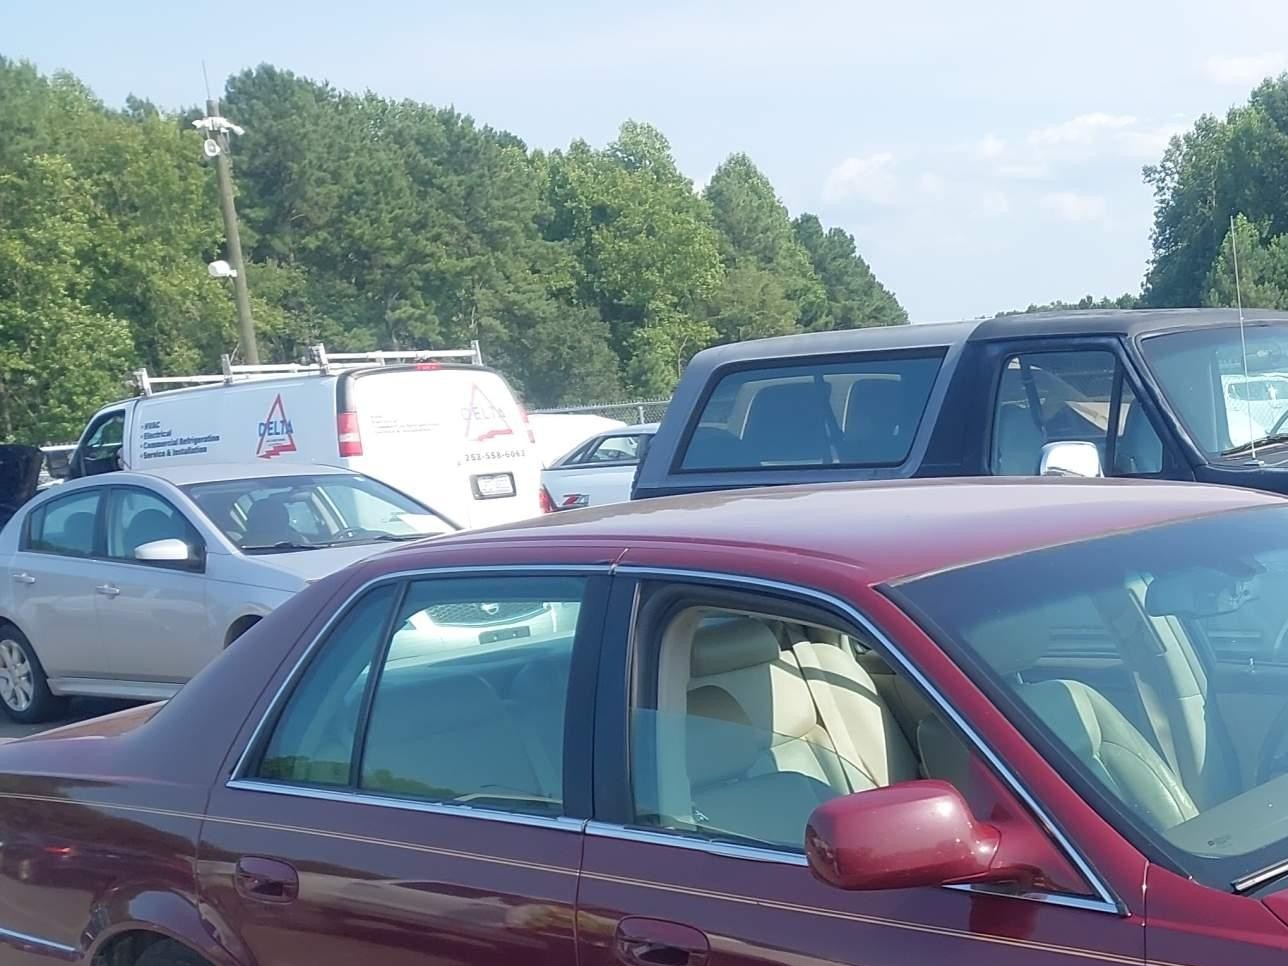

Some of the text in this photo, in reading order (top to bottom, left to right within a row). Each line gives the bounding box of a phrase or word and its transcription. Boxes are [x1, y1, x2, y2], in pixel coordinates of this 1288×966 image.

[460, 407, 506, 421] DELTA
[143, 430, 171, 439] Electrical
[258, 420, 294, 437] DELTA
[143, 435, 219, 449] Commercial Refrigeration
[143, 450, 165, 459] Service
[172, 446, 207, 457] Installation
